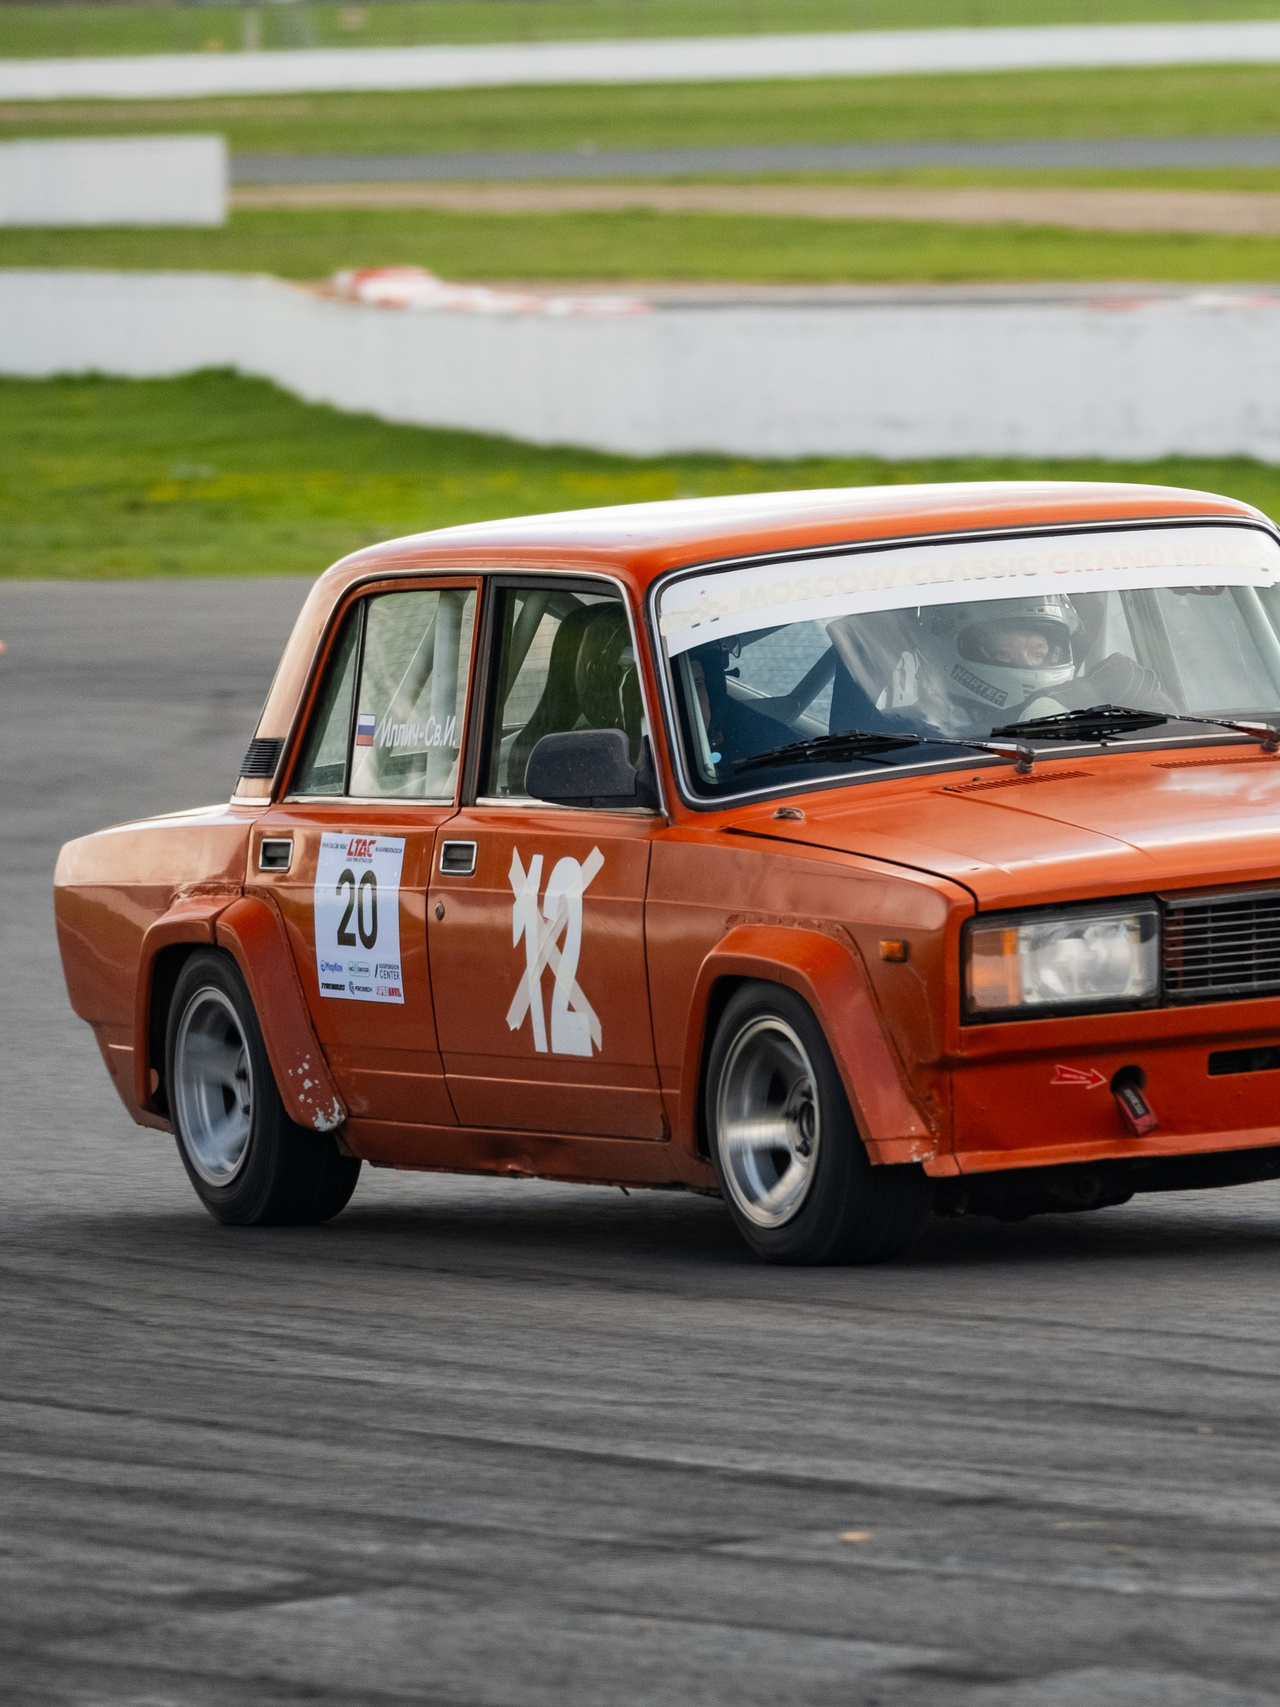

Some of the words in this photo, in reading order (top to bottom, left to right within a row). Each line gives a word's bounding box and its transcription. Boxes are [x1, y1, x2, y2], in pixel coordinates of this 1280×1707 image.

[737, 567, 898, 611] MOSCOW
[908, 554, 1038, 585] CLASSIC
[1046, 547, 1165, 575] GRAND
[1174, 545, 1243, 567] PRIX
[346, 838, 377, 858] LTAC
[335, 868, 378, 950] 20
[379, 969, 400, 981] CENTER
